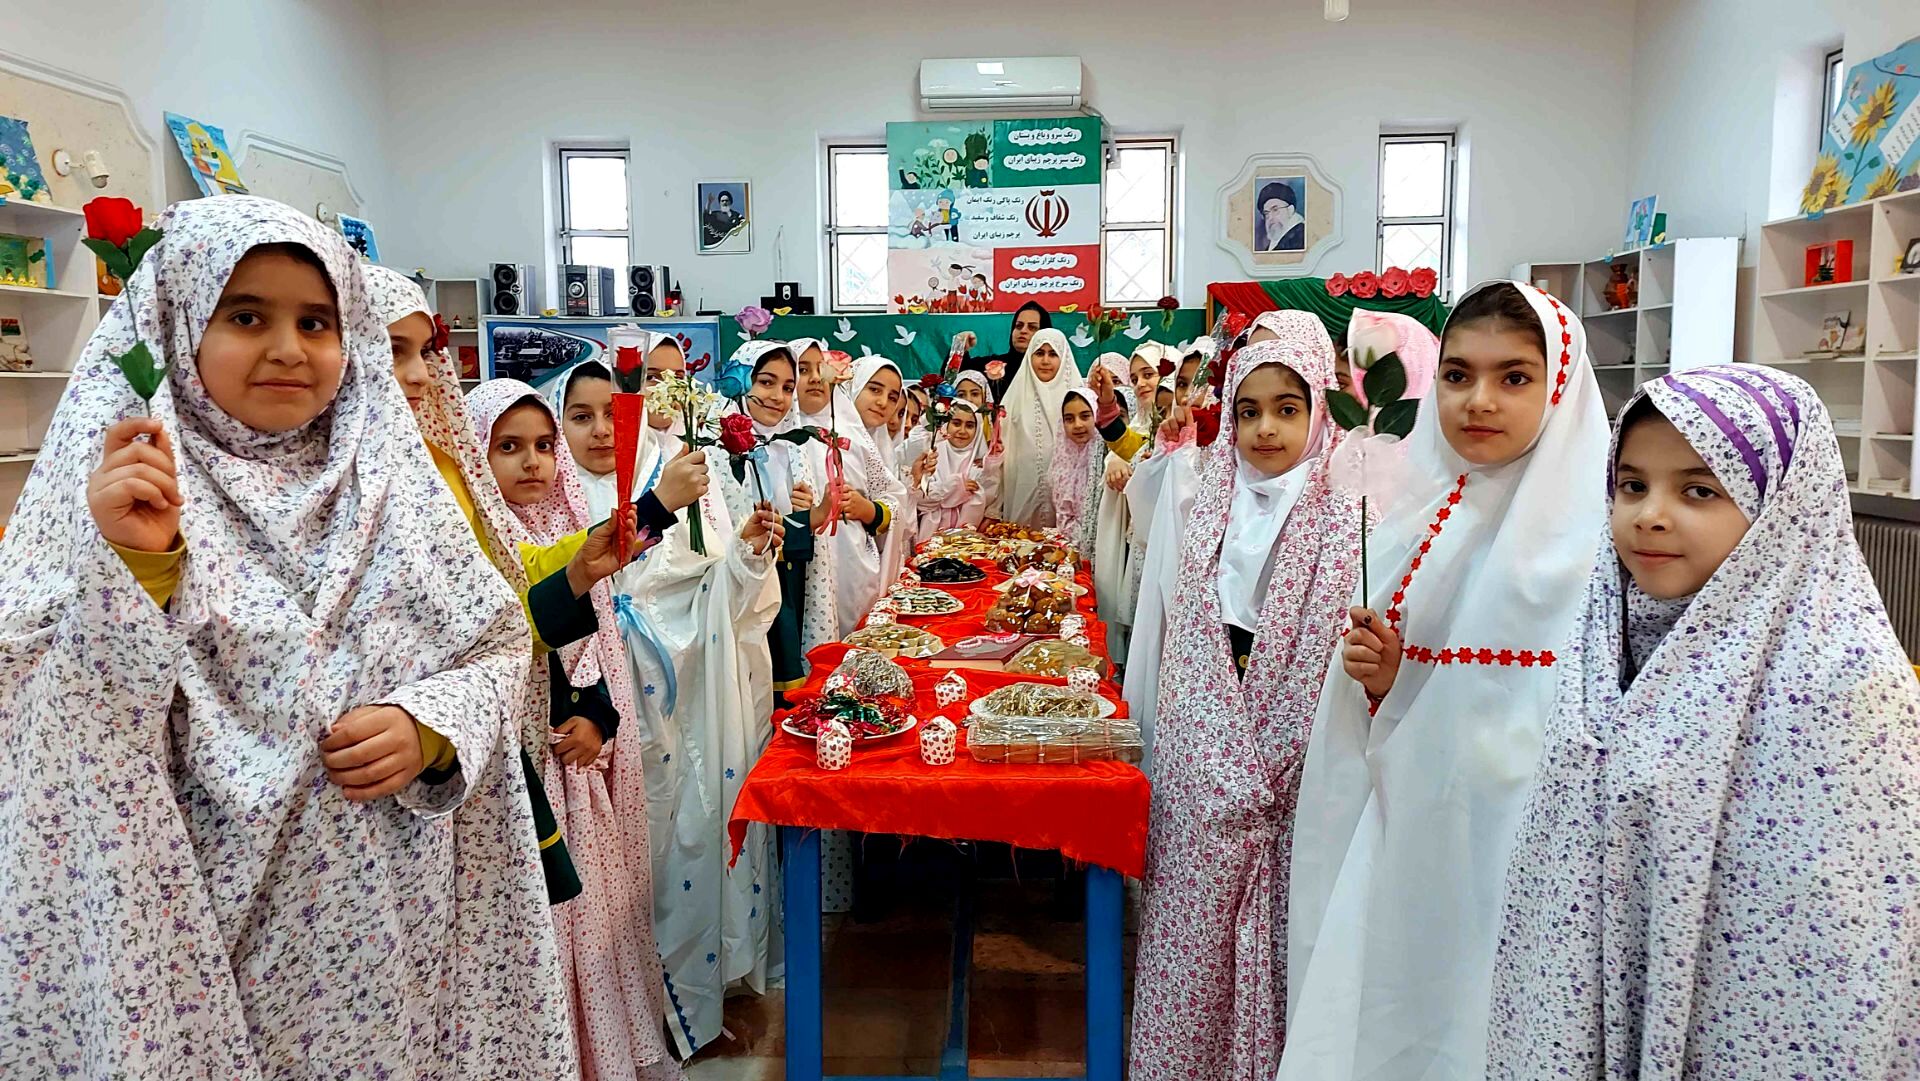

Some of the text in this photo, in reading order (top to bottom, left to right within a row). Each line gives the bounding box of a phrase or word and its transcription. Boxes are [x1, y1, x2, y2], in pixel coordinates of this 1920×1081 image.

[1008, 156, 1024, 165] ایران
[967, 196, 982, 204] ایمان
[990, 213, 1005, 221] شفاف
[973, 231, 988, 239] ایران
[1019, 257, 1040, 265] شهیدان
[1005, 280, 1020, 288] ایران
